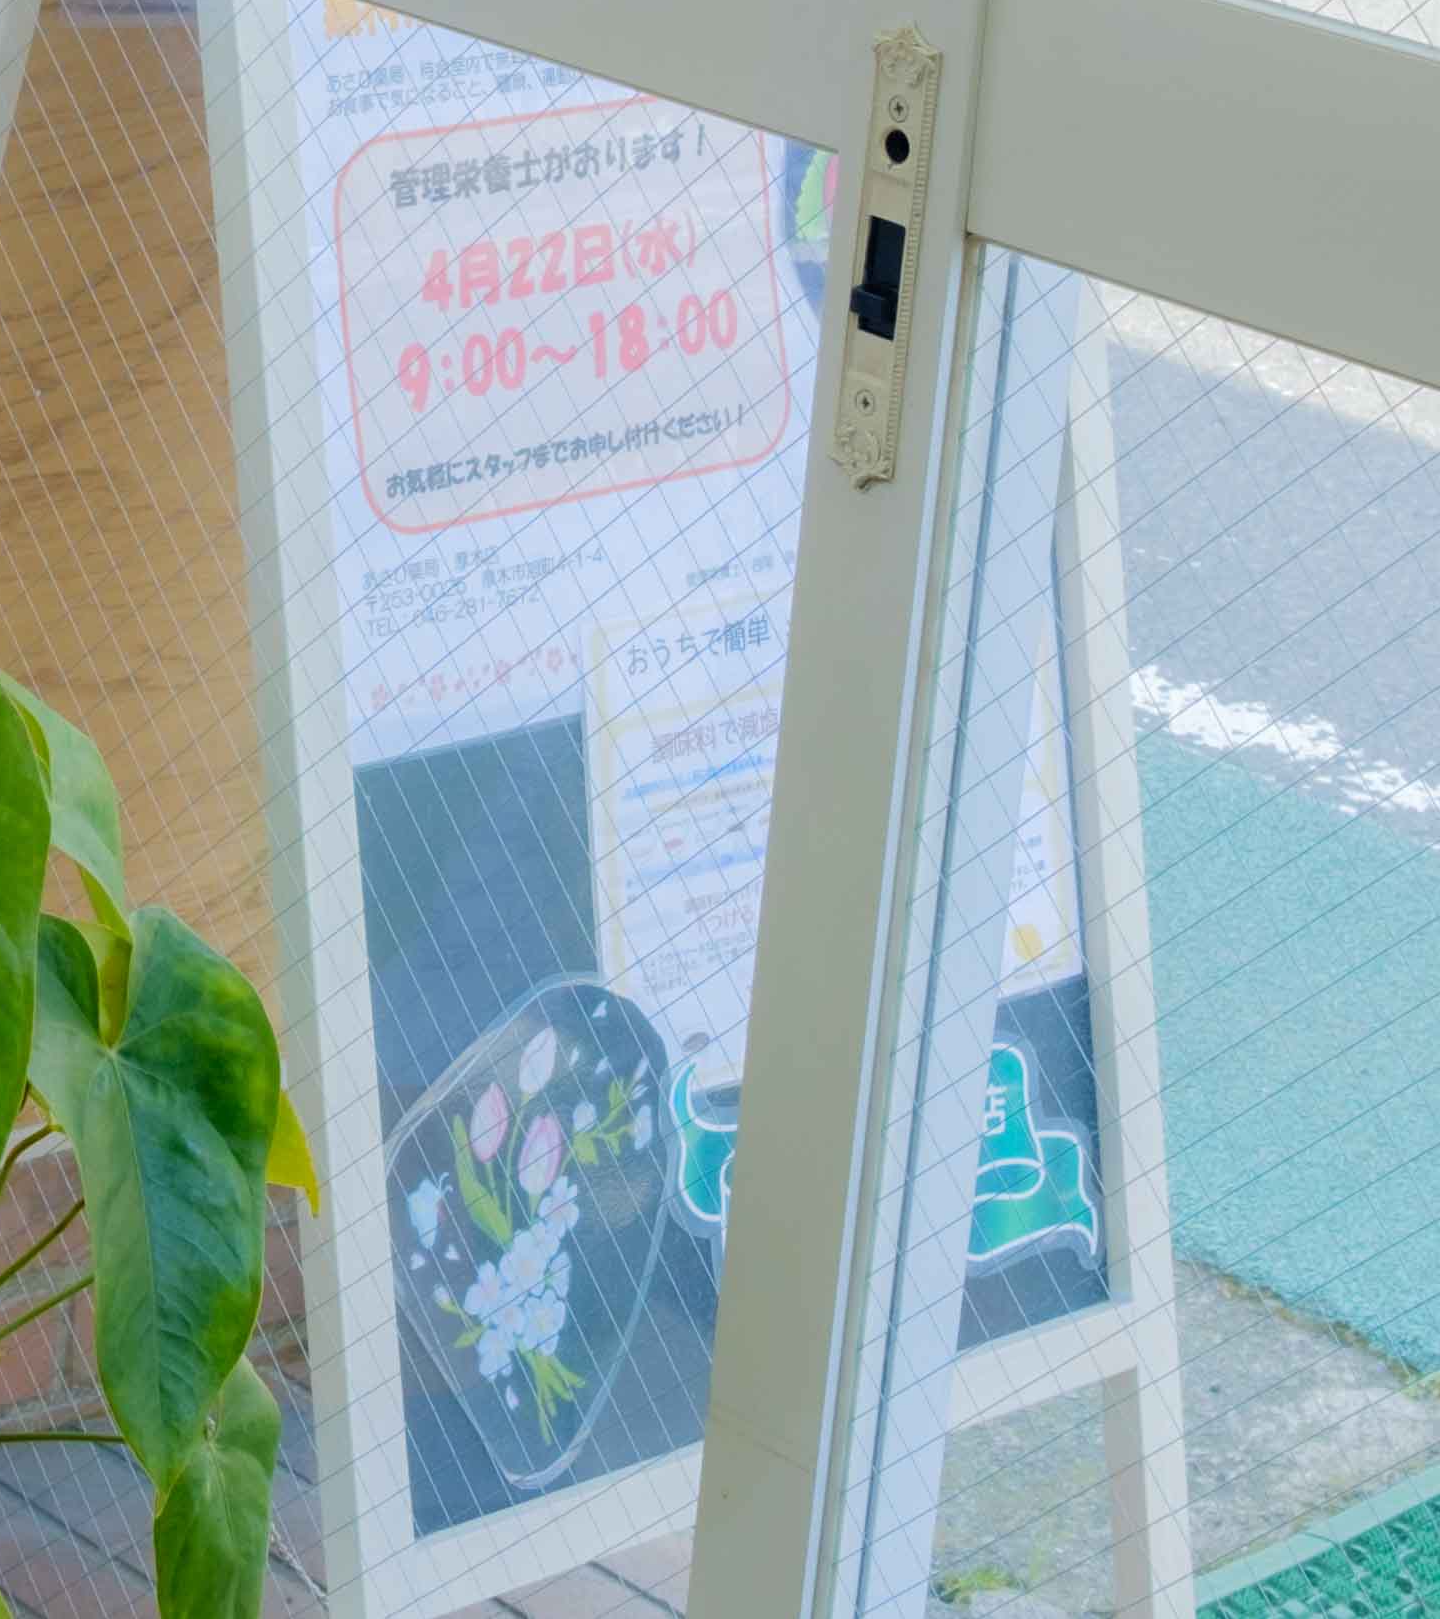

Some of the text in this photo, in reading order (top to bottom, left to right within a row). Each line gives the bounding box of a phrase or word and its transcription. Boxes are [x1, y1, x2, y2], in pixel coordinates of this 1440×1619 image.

[389, 123, 705, 210] 管理栄養士がおります！
[421, 214, 699, 313] 4月22日(水)
[627, 614, 770, 677] おうちで簡単
